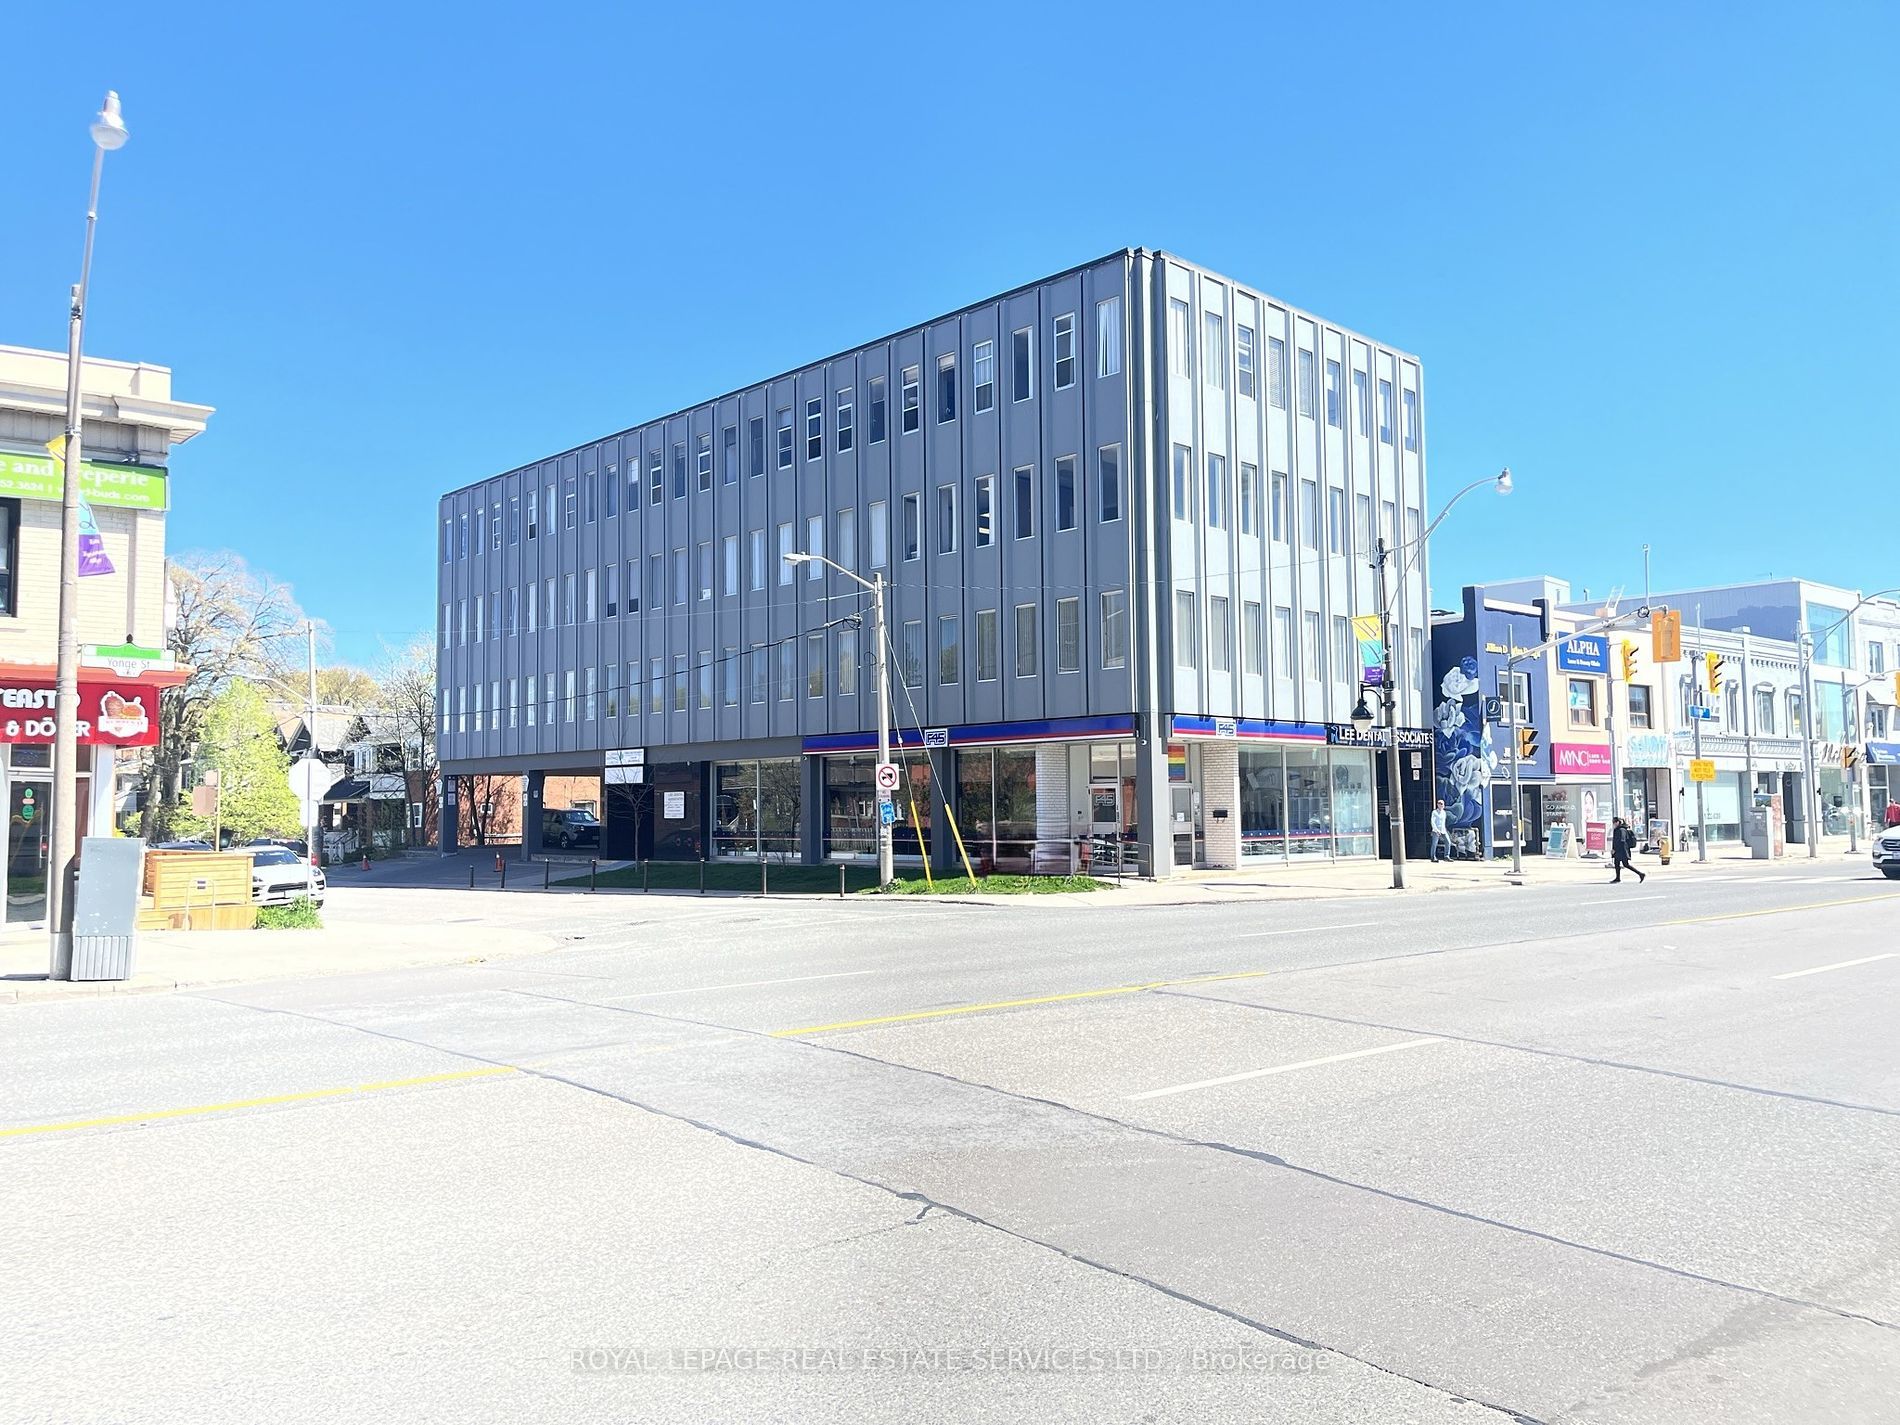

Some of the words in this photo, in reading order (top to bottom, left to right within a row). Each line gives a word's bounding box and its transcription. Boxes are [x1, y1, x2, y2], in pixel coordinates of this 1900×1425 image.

[13, 461, 53, 476] and
[1567, 640, 1600, 656] ALPHA
[107, 658, 137, 669] Yonge
[141, 659, 150, 669] St
[6, 720, 20, 737] &
[1218, 723, 1235, 735] F45
[1339, 725, 1355, 741] LEE
[1396, 731, 1433, 744] SSOCIATES
[927, 732, 945, 744] F45
[1559, 749, 1587, 767] MYNC
